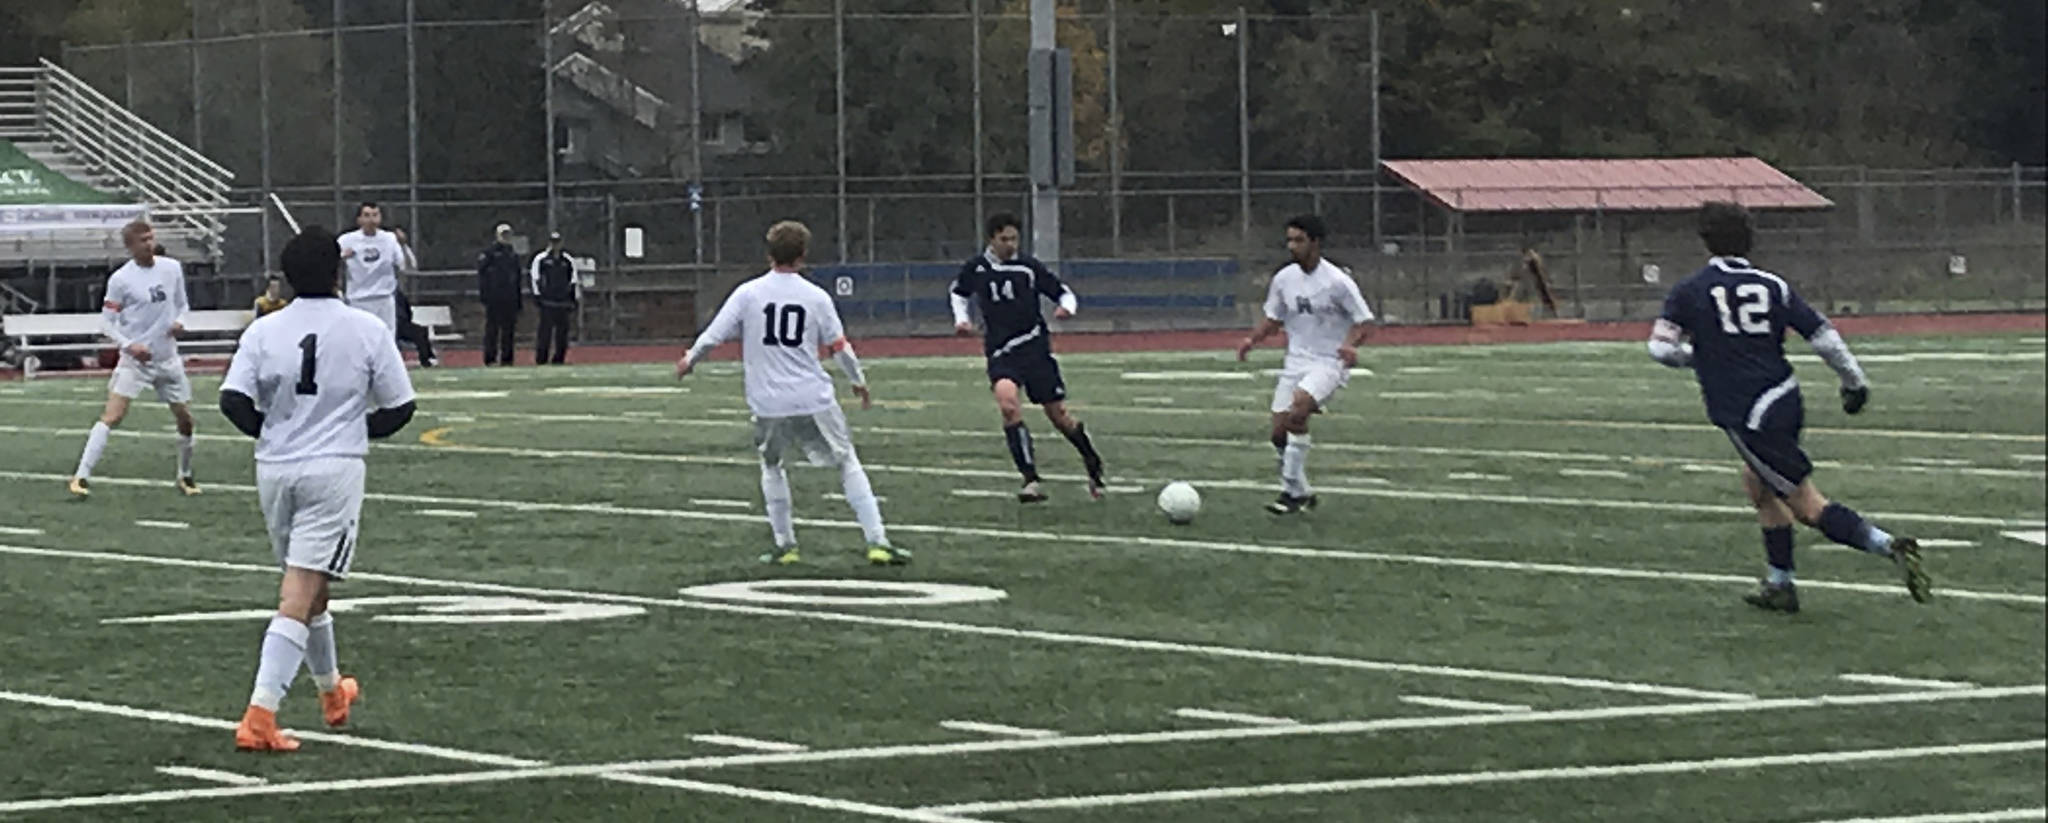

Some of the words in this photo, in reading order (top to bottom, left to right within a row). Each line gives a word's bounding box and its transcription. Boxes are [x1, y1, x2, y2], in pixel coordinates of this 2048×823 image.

[989, 280, 1015, 302] 14
[1710, 284, 1770, 334] 12
[763, 303, 806, 348] 10
[296, 333, 318, 396] 1
